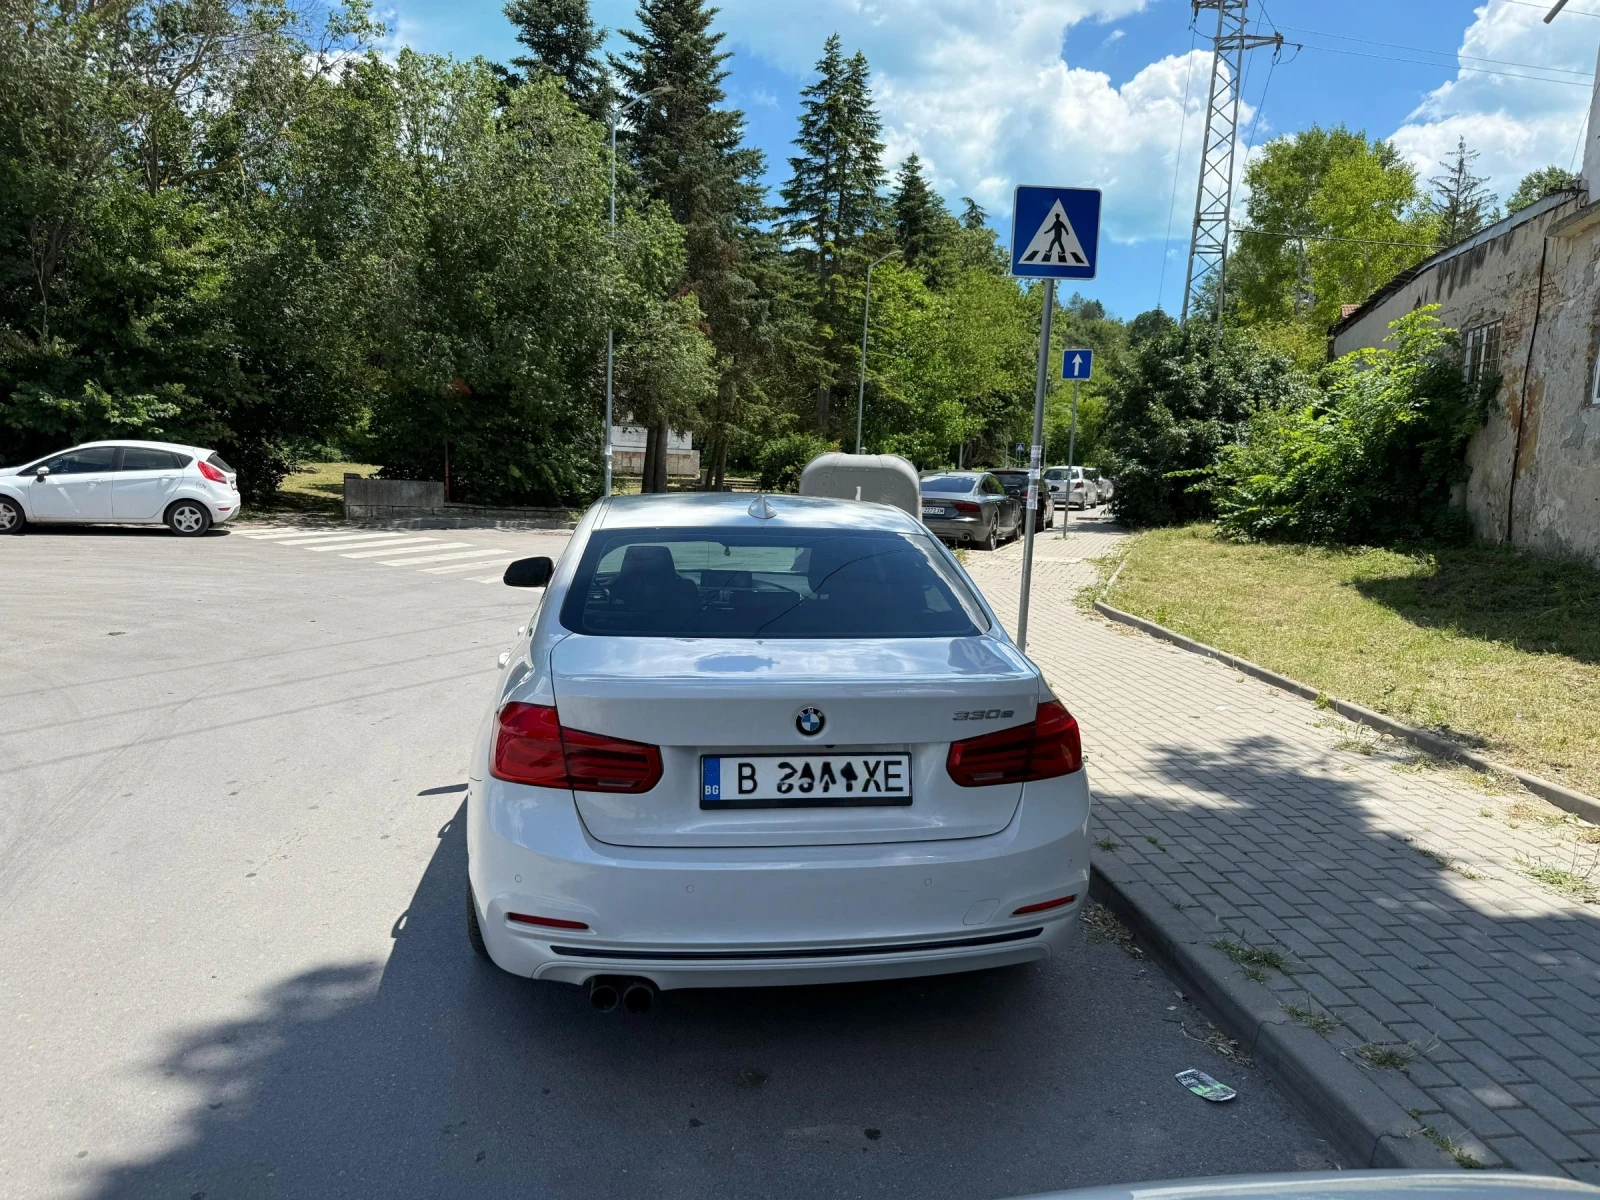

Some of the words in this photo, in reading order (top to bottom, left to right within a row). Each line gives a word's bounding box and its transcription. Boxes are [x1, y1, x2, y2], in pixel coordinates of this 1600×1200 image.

[952, 709, 1014, 720] 330e
[738, 763, 758, 794] B
[705, 785, 719, 795] BG
